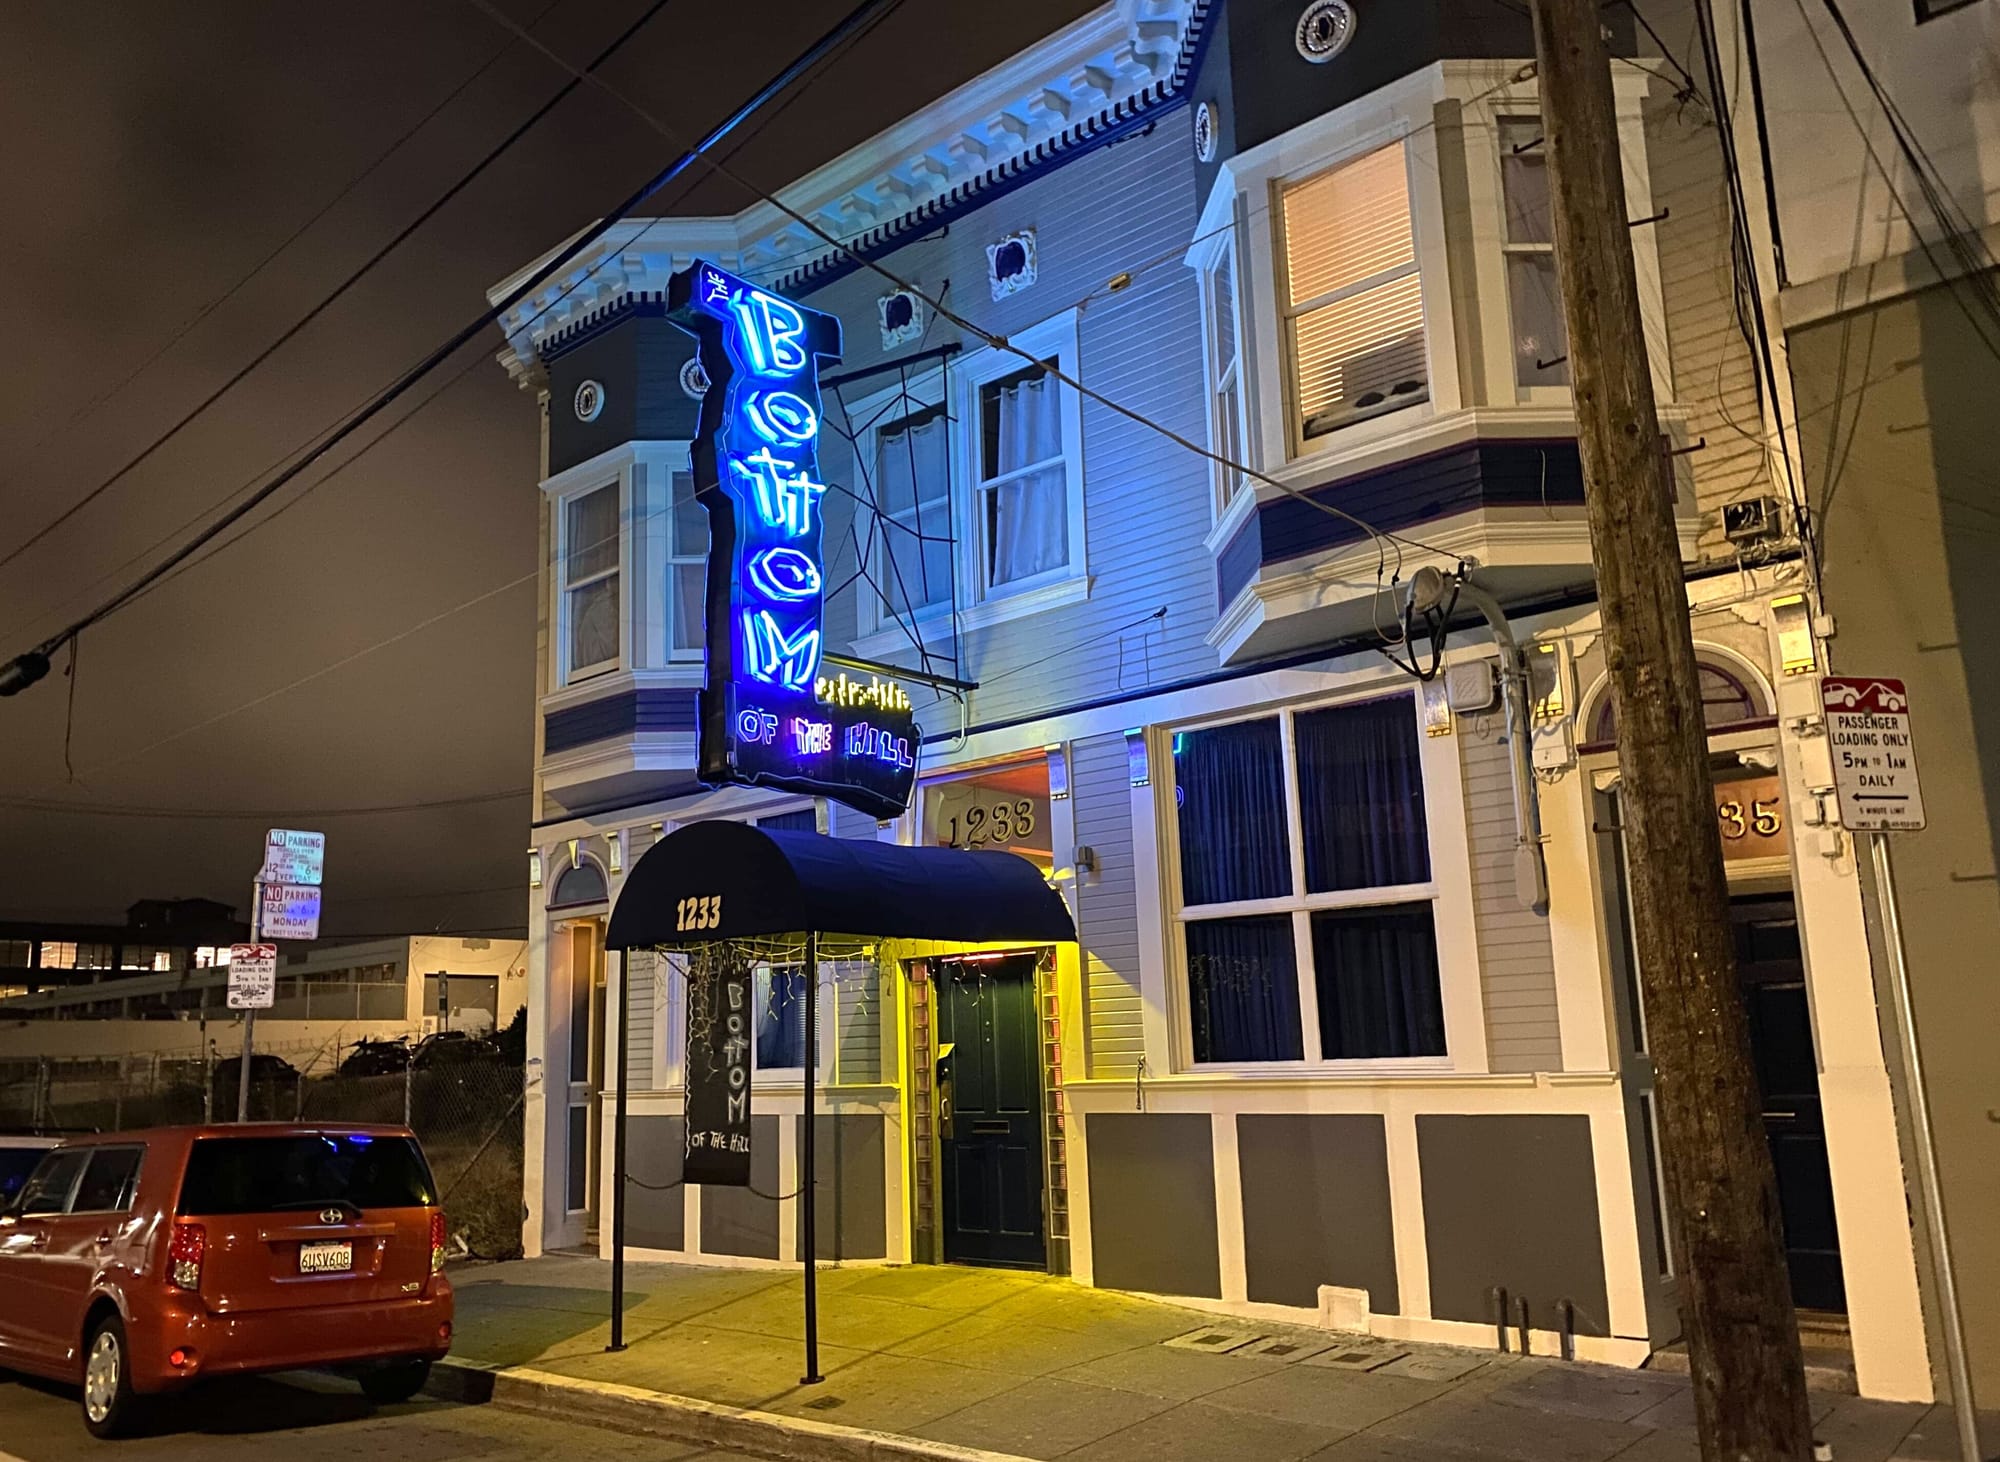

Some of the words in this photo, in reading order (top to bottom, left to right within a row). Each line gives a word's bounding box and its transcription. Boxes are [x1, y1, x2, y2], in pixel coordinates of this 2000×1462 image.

[706, 271, 730, 302] THE
[1838, 715, 1899, 730] PASSENGER
[738, 709, 779, 745] OF
[791, 717, 832, 754] THE
[846, 721, 913, 768] HILL
[1832, 732, 1879, 746] LOADING
[1882, 733, 1909, 746] ONLY
[1842, 751, 1868, 769] 5PM
[1886, 752, 1907, 769] 1AM
[1859, 775, 1895, 787] DAILY
[949, 799, 1035, 848] 1233
[270, 831, 285, 845] NO
[288, 836, 321, 848] PARKING
[266, 886, 282, 900] NO
[284, 890, 319, 901] PARKING
[273, 917, 307, 926] MONDAY
[677, 895, 722, 931] 1233
[691, 1131, 706, 1147] OF
[710, 1130, 728, 1149] THE
[301, 1251, 350, 1269] 6USV608
